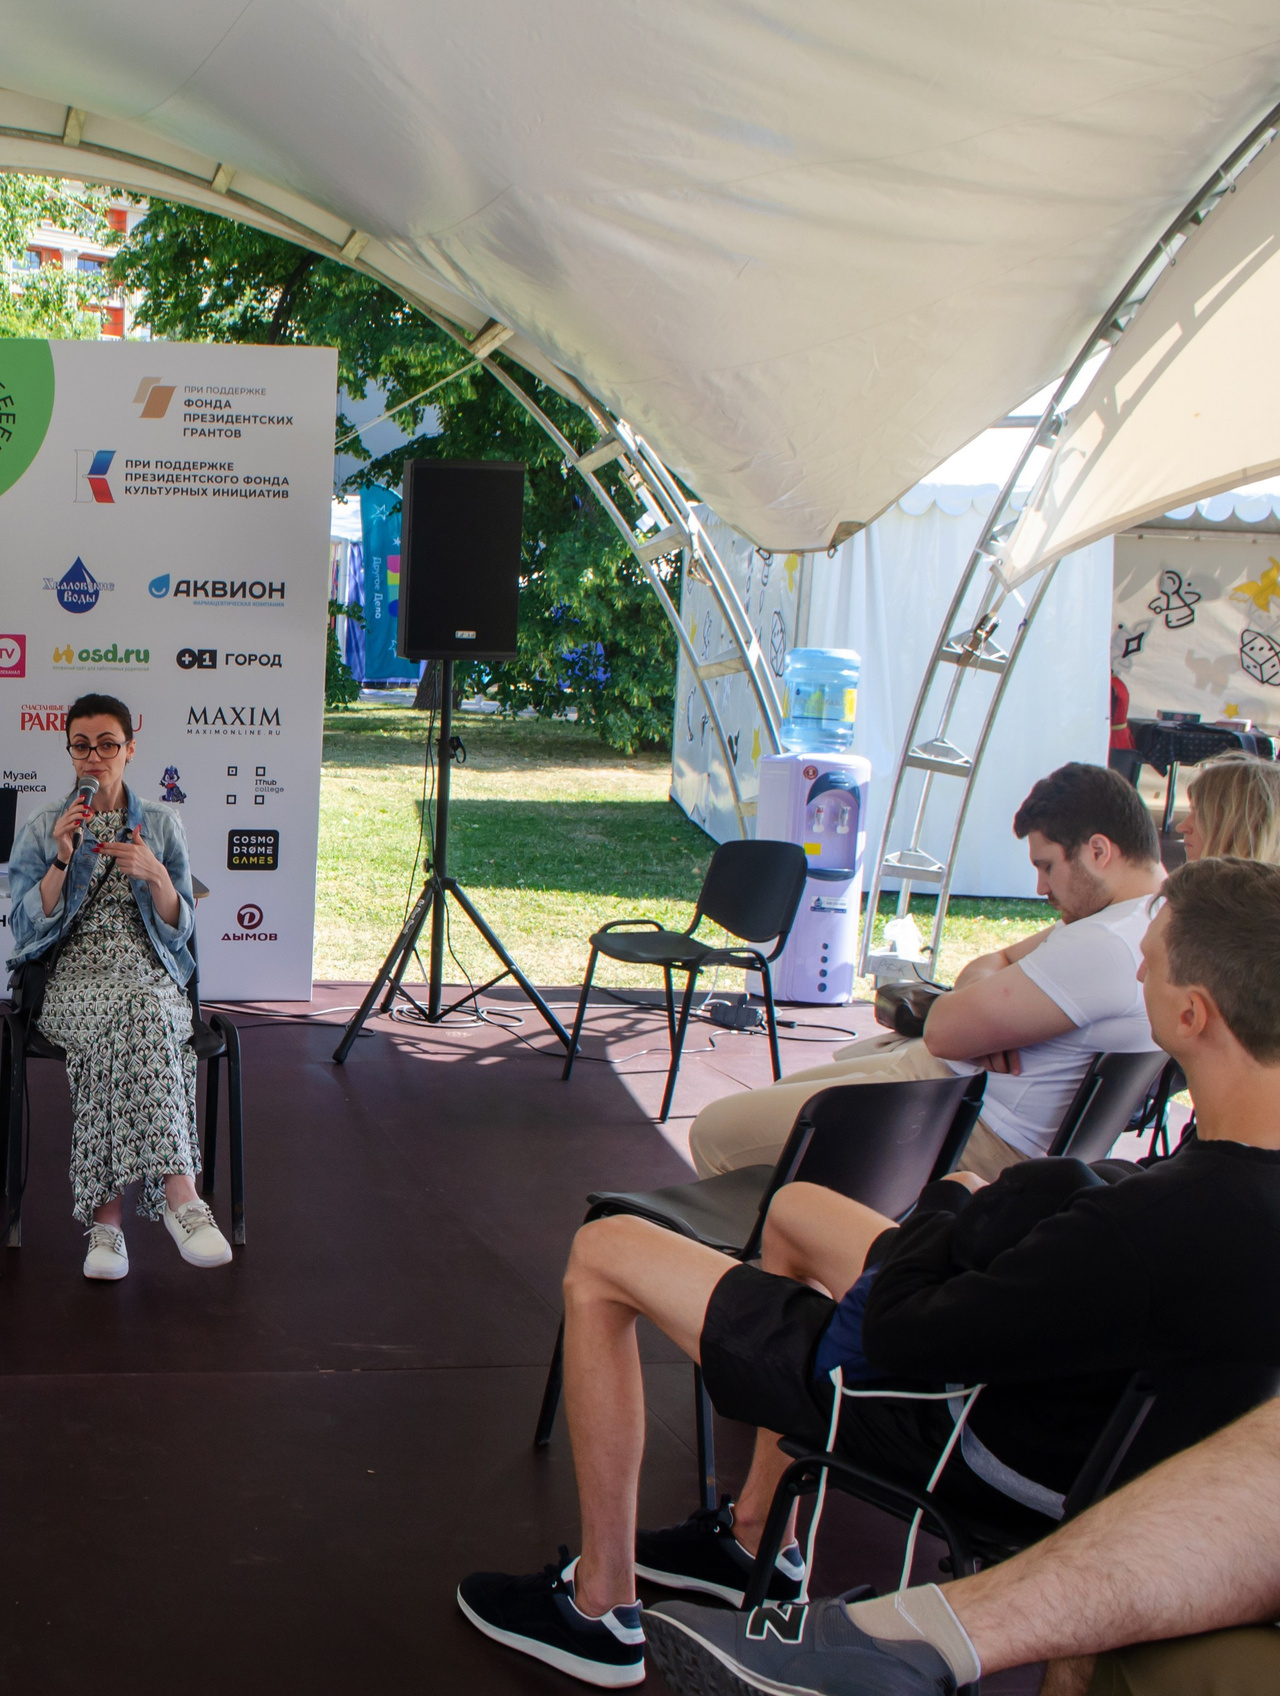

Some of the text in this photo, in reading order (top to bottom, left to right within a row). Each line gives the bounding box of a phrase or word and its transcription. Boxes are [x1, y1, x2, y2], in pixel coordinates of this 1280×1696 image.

[184, 386, 266, 396] ПРИ ПОДДЕРЖКЕ
[184, 398, 232, 410] ФОНДА
[183, 413, 293, 426] ПРЕЗИДЕНТСКИХ
[183, 427, 242, 438] ГРАНТОВ
[125, 460, 234, 471] ПРИ ПОДДЕРЖКЕ
[125, 473, 290, 486] ПРЕЗИДЕНТСКОГО ФОНДА
[125, 486, 289, 499] КУЛЬТУРНЫХ ИНИЦИАТИВ
[173, 580, 285, 600] АКВИОН
[63, 591, 96, 605] Воды
[373, 593, 384, 620] Дело
[225, 653, 283, 668] ГОРОД
[21, 704, 64, 712] СЧАСТЛИВЫЕ
[186, 706, 281, 726] MAXIM
[3, 770, 38, 782] Музей
[254, 786, 285, 794] college
[233, 836, 274, 844] COSMO
[232, 856, 274, 865] GAMES
[221, 933, 278, 941] ДЫМОВ
